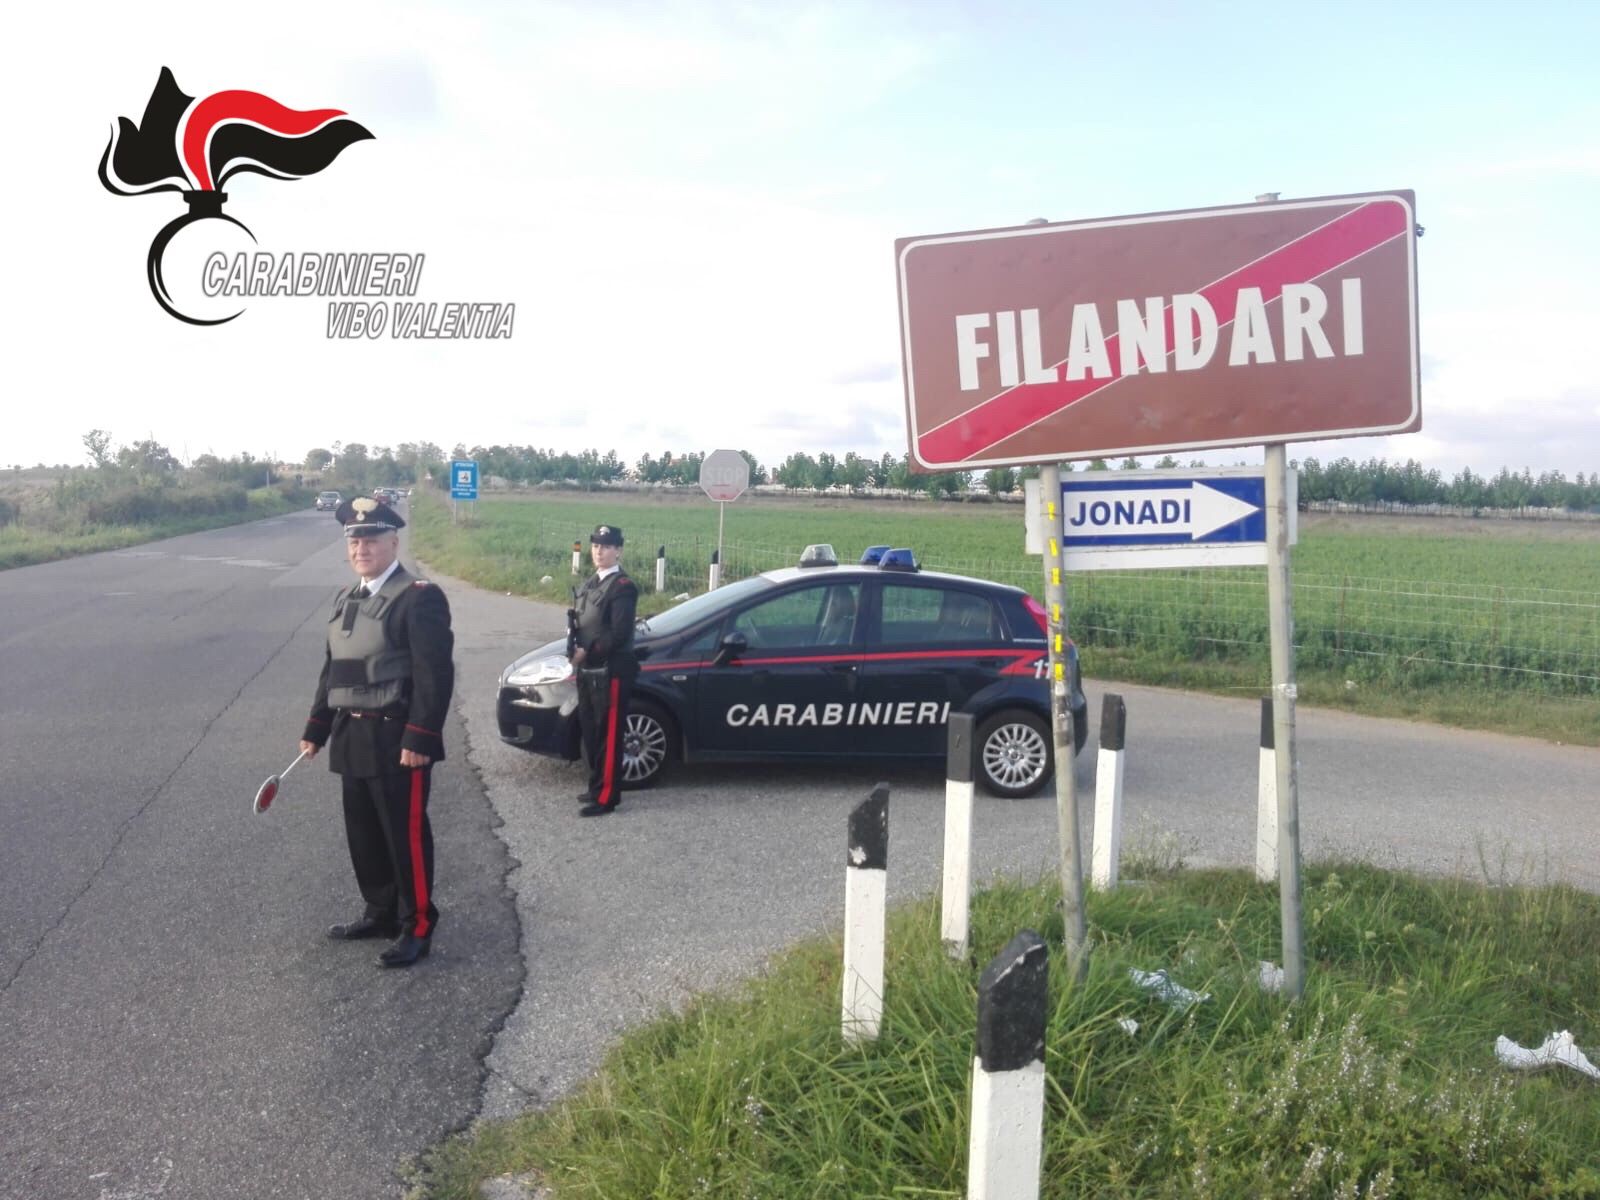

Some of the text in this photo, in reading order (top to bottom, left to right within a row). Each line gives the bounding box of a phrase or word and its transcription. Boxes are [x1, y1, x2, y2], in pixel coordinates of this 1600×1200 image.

[955, 277, 1364, 391] FILANDARI
[1070, 499, 1192, 527] JONADI
[727, 701, 951, 727] CARABINIERI
